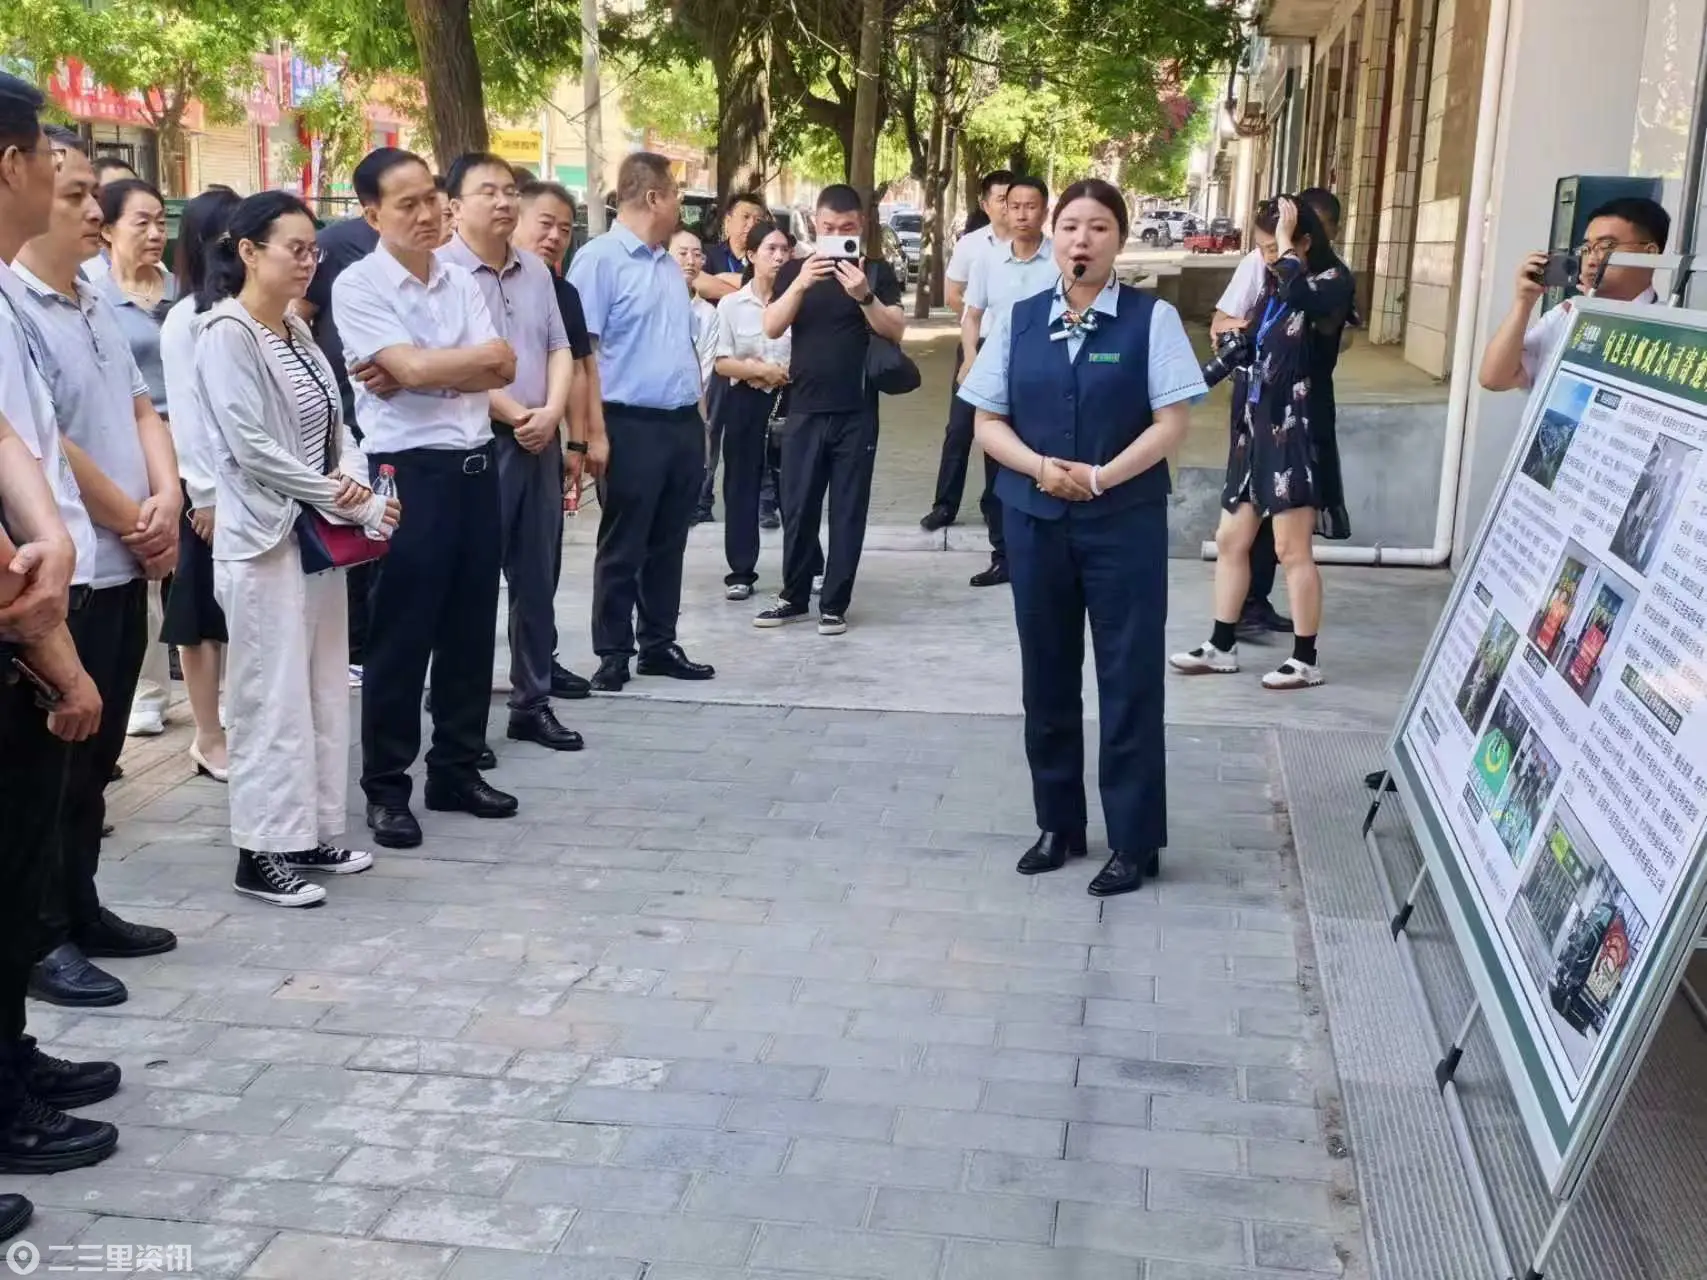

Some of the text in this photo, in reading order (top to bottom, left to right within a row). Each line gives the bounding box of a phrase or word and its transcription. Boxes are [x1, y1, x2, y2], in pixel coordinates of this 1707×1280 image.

[1602, 330, 1707, 393] 旬邑县邮政公司寄递
